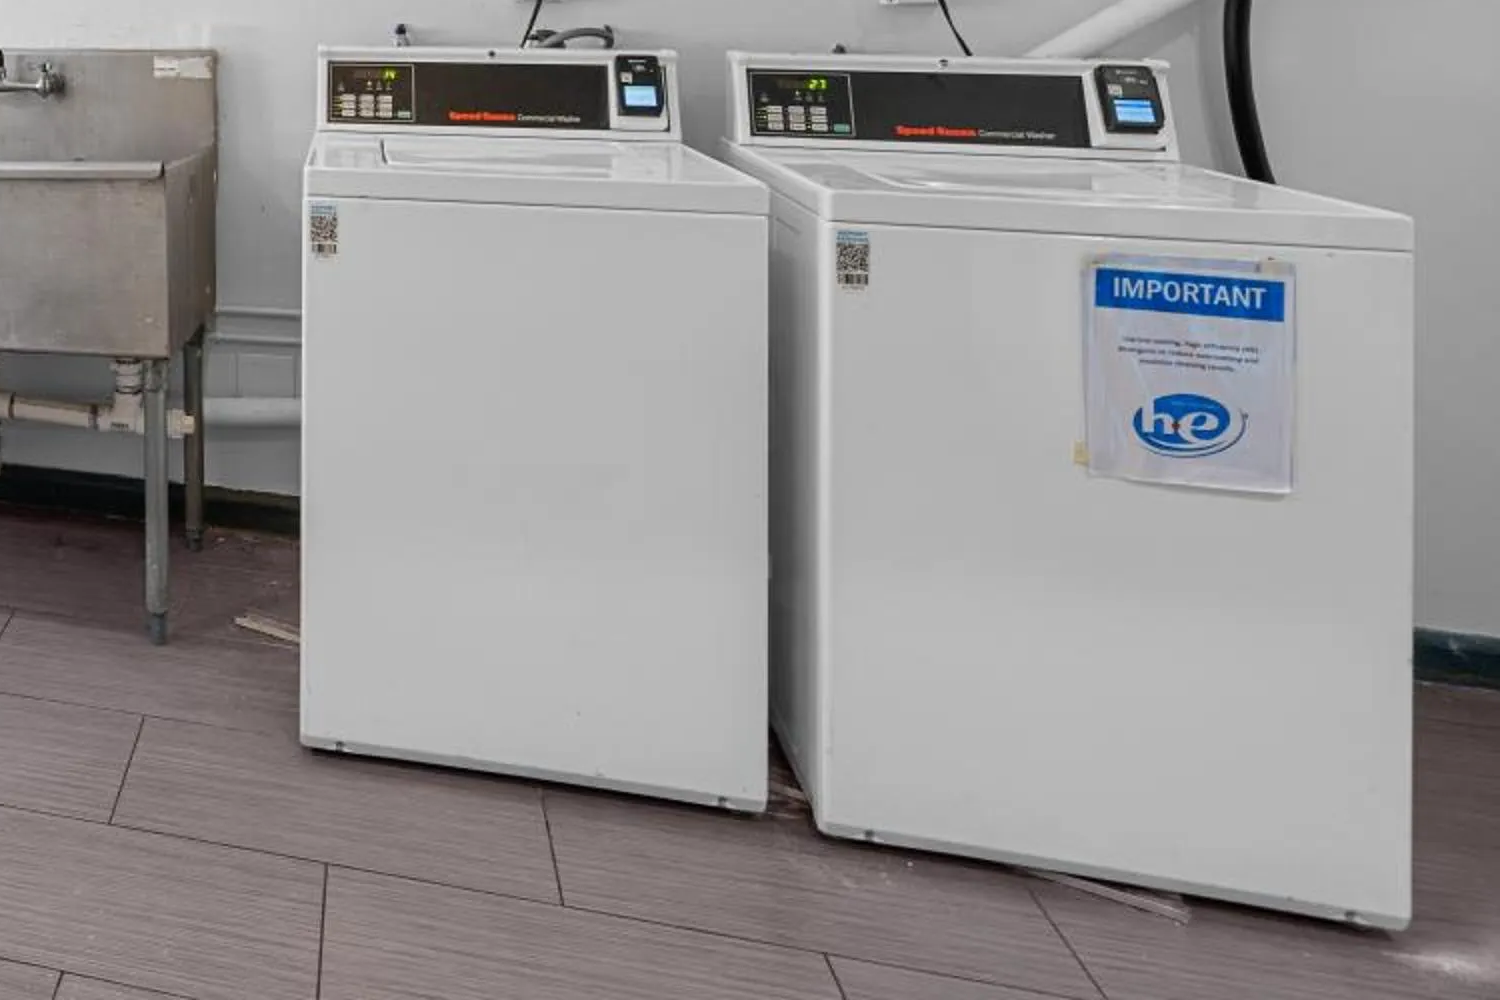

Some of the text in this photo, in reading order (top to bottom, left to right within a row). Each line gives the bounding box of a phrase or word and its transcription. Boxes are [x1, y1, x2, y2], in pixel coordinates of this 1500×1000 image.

[896, 125, 935, 138] Speed
[1112, 276, 1268, 310] IMPORTANT
[1141, 396, 1220, 446] he
